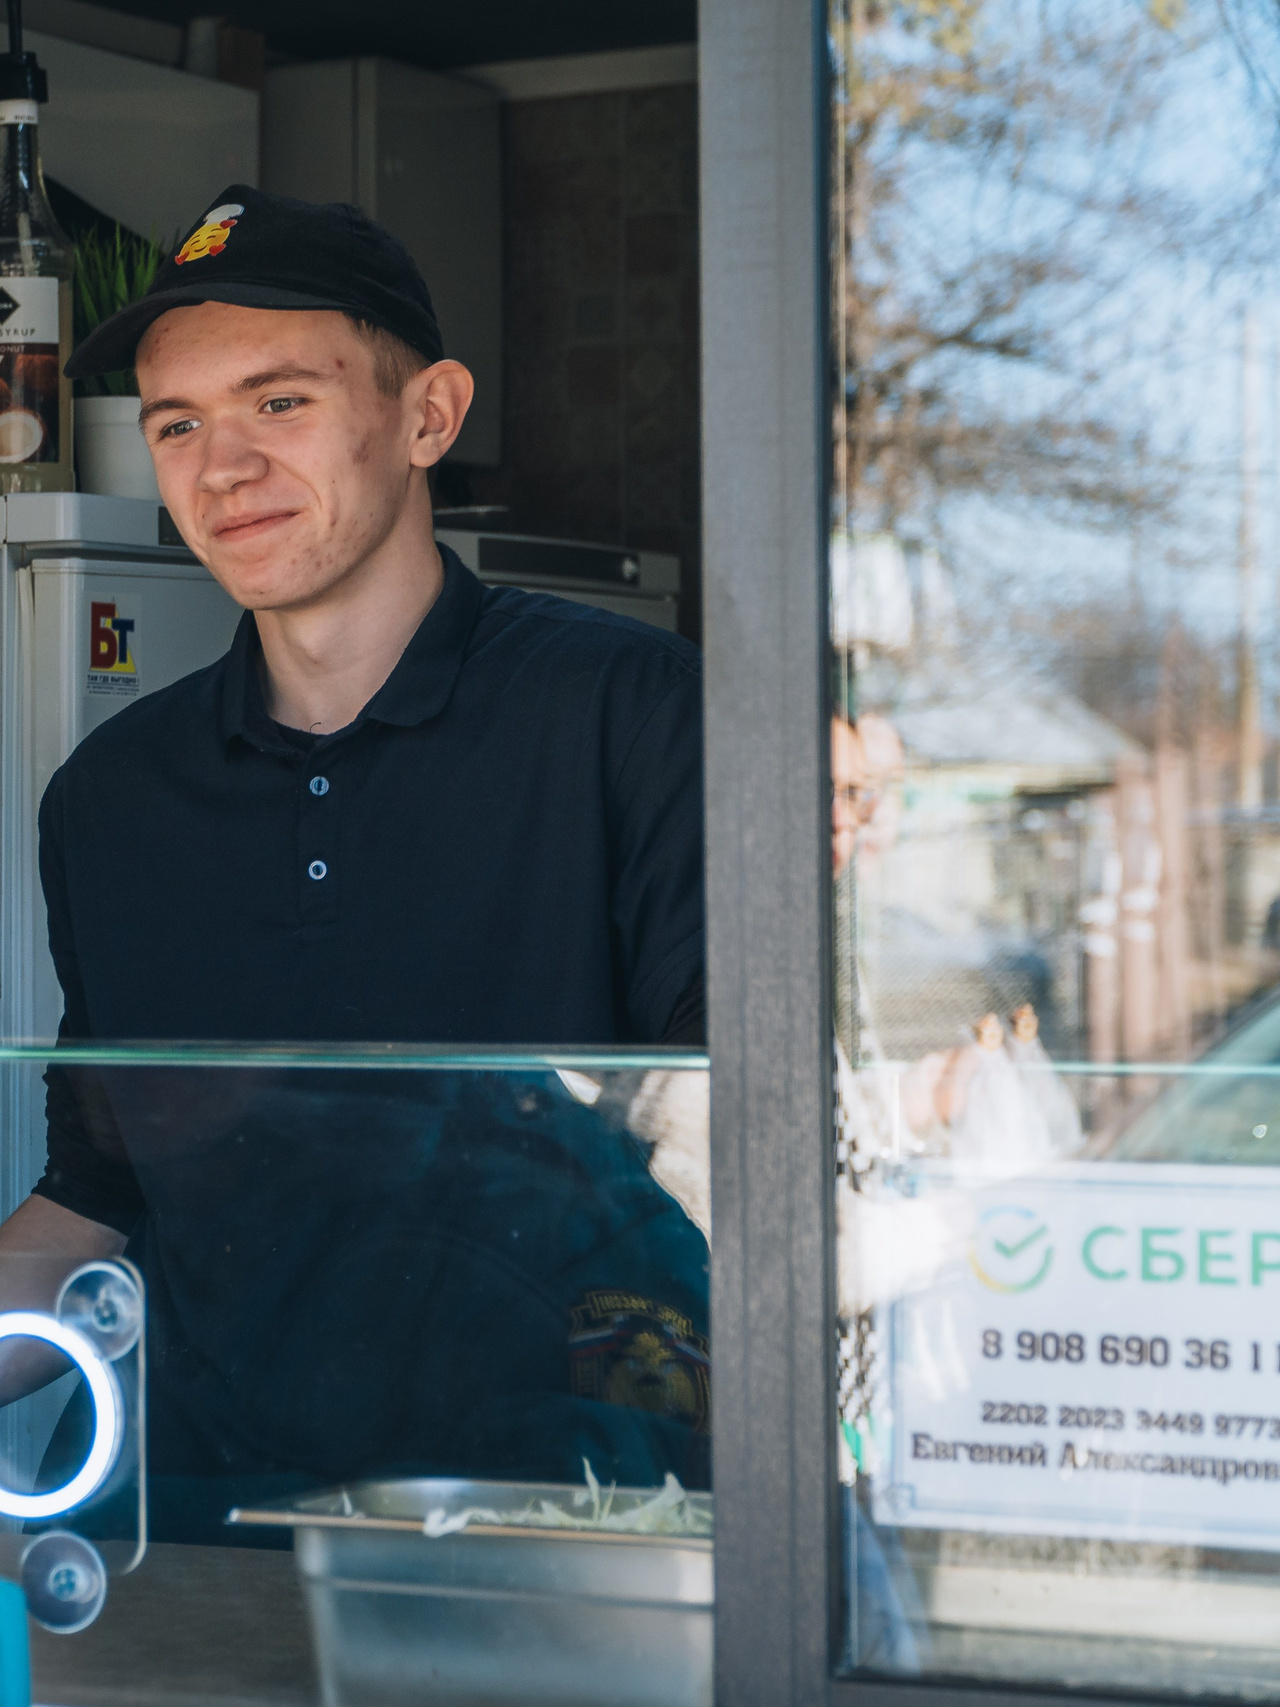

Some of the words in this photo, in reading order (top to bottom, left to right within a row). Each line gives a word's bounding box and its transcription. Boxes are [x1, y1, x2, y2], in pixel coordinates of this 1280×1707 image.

[0, 327, 36, 337] SYRUP
[1082, 1226, 1280, 1287] СБЕР
[982, 1329, 1002, 1359] 8
[1017, 1331, 1085, 1363] 908
[1100, 1334, 1169, 1367] 690
[1184, 1339, 1230, 1370] 36
[1251, 1341, 1280, 1373] 1
[982, 1401, 1048, 1426] 2202
[1059, 1405, 1124, 1430] 2023
[912, 1432, 1047, 1467] Евгений
